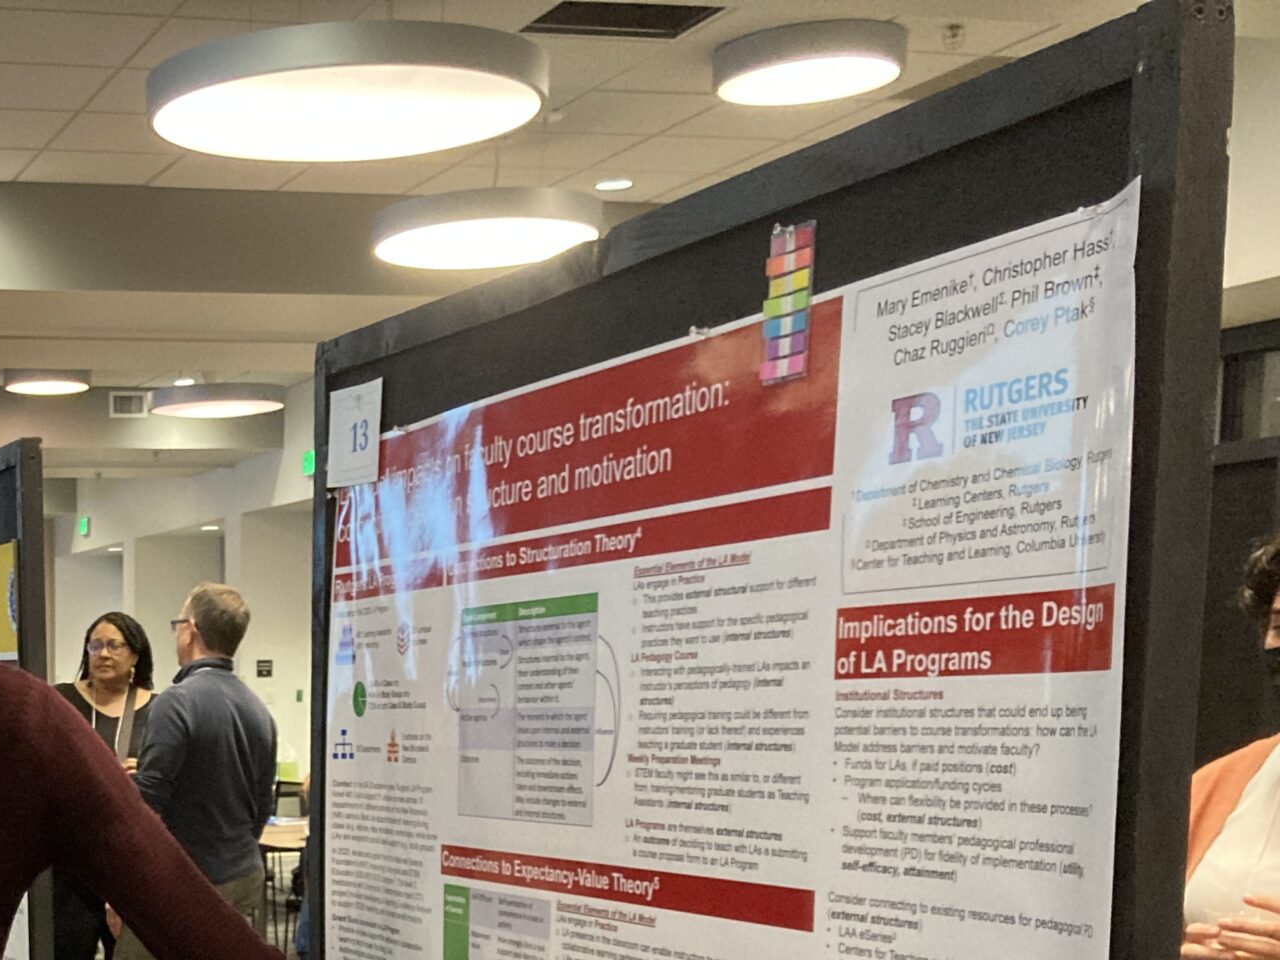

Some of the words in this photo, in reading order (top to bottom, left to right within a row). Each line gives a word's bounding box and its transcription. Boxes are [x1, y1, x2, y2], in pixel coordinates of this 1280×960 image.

[877, 295, 908, 318] Mary
[982, 248, 1068, 287] Christopher
[888, 315, 931, 343] Stacey
[1011, 287, 1039, 309] Phil
[893, 344, 925, 366] Chaz
[1004, 312, 1049, 339] Corey
[964, 368, 1068, 414] RUTGERS
[516, 422, 574, 458] course
[579, 380, 731, 442] transformation:
[964, 416, 983, 431] THE
[986, 409, 1018, 427] STATE
[1022, 396, 1088, 420] UNIVERSITY
[351, 419, 368, 453] 13
[963, 435, 977, 449] OF
[980, 429, 1004, 445] NEW
[1006, 421, 1046, 443] JERSEY
[537, 464, 568, 498] and
[574, 444, 671, 491] motivation
[908, 481, 917, 493] of
[920, 471, 968, 495] Chemistry
[971, 468, 990, 484] and
[994, 460, 1041, 481] Chemical
[1009, 481, 1049, 497] Rutgers
[943, 511, 952, 524] of
[1020, 499, 1061, 516] Rutgers
[506, 550, 516, 567] to
[519, 537, 592, 565] Structuration
[902, 547, 943, 568] Teaching
[947, 546, 965, 561] and
[1016, 535, 1065, 555] Columbia
[927, 533, 937, 546] of
[938, 525, 976, 546] Physics
[979, 524, 997, 537] and
[838, 610, 958, 644] Implications
[964, 606, 994, 631] for
[1000, 604, 1034, 629] the
[1041, 600, 1104, 630] Design
[837, 651, 857, 674] of
[860, 651, 886, 672] LA
[892, 649, 992, 677] Programs
[892, 689, 944, 701] Structures
[1028, 706, 1048, 717] end
[1050, 708, 1063, 720] up
[441, 850, 499, 875] Connections
[501, 860, 512, 876] to
[514, 863, 609, 891] Expectancy-Value
